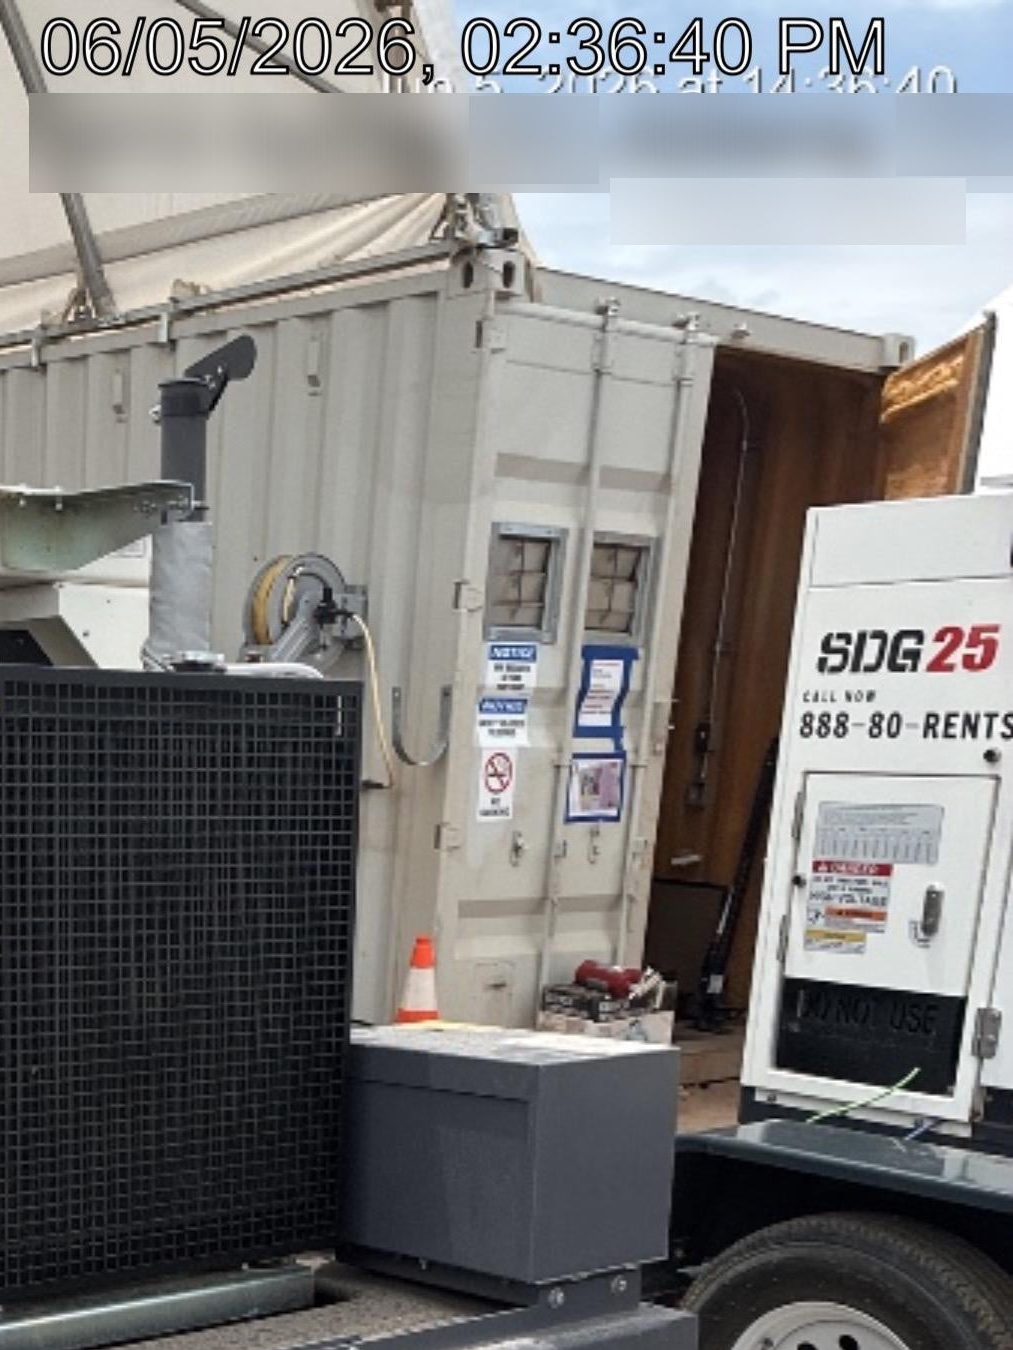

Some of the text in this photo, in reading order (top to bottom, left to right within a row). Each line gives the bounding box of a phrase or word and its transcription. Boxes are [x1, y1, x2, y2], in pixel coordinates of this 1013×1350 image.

[816, 624, 1001, 673] SDG 25
[803, 690, 837, 703] CALL
[799, 711, 1013, 740] 888-80-RENTS
